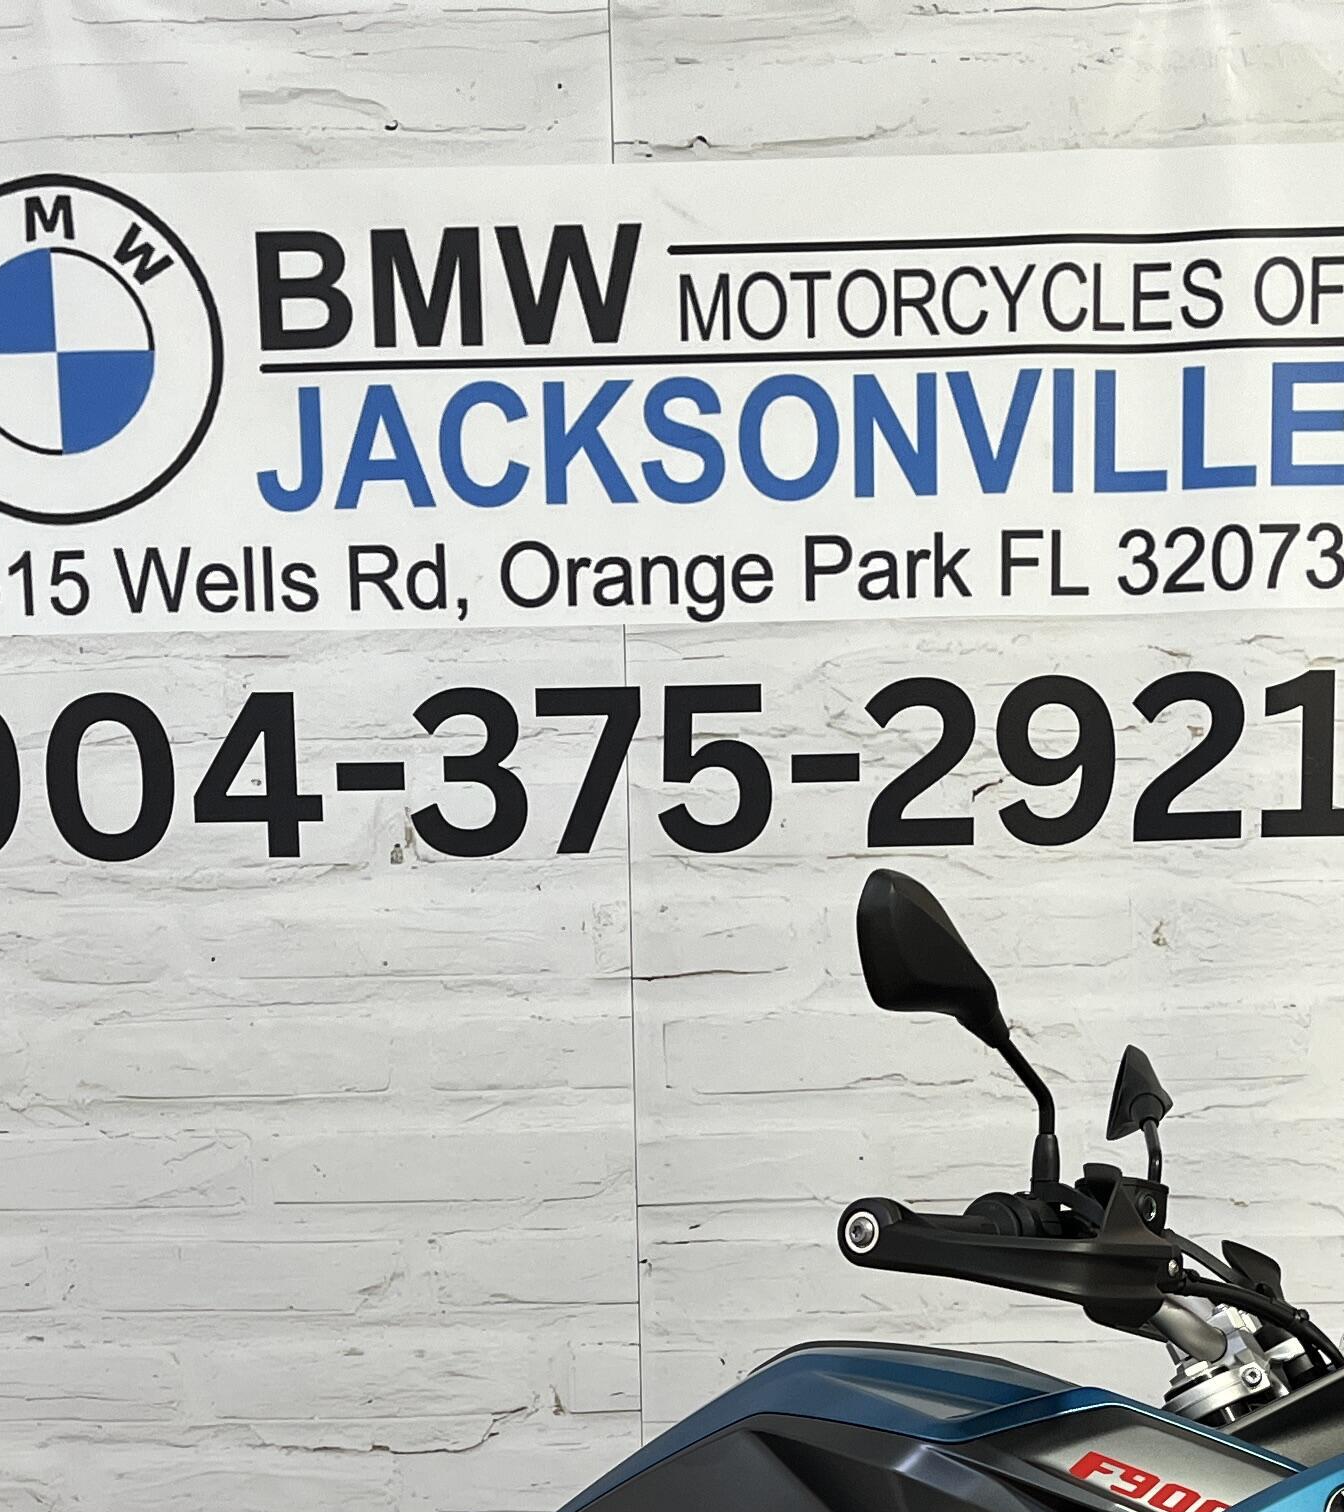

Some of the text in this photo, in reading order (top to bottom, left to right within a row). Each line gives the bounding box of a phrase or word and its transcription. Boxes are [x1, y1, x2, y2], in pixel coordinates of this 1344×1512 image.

[255, 223, 640, 351] BMW
[680, 259, 1224, 342] MOTORCYCLES
[115, 545, 320, 614] Wells
[350, 544, 467, 621] Rd,
[501, 540, 773, 622] Orange
[805, 531, 970, 601] Park
[1001, 529, 1089, 597] FL
